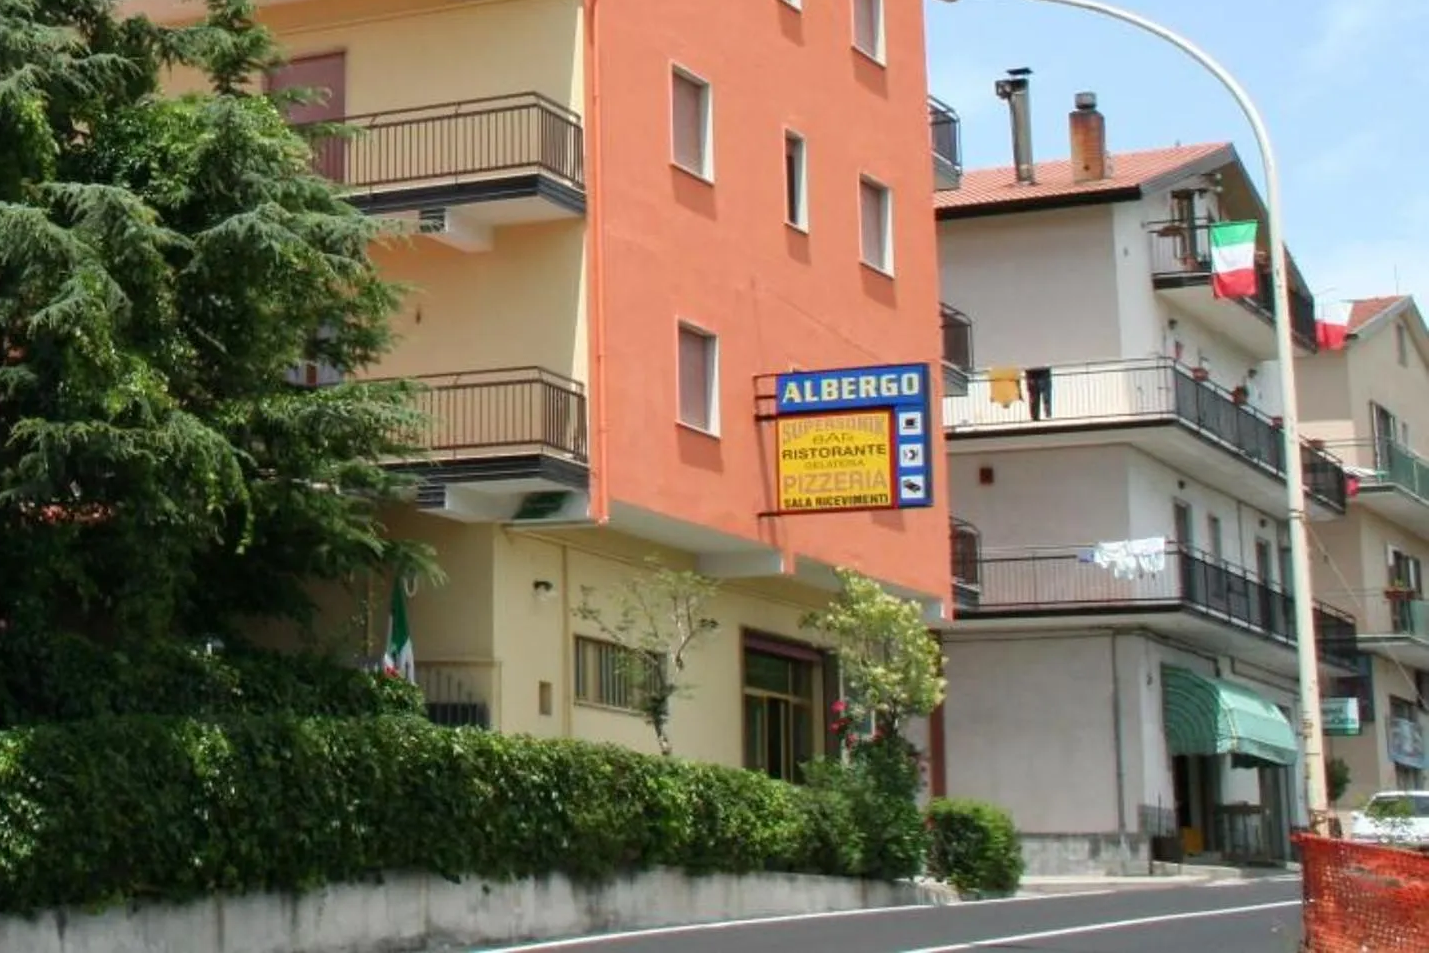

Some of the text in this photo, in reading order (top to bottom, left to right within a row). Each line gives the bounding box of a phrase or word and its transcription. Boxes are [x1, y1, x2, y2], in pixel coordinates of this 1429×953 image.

[781, 372, 921, 404] ALBERGO
[812, 432, 854, 445] BAR
[782, 444, 887, 460] RISTORANTE
[783, 469, 888, 495] PIZZERIA
[784, 493, 889, 508] SALA RICEVIMENTI
